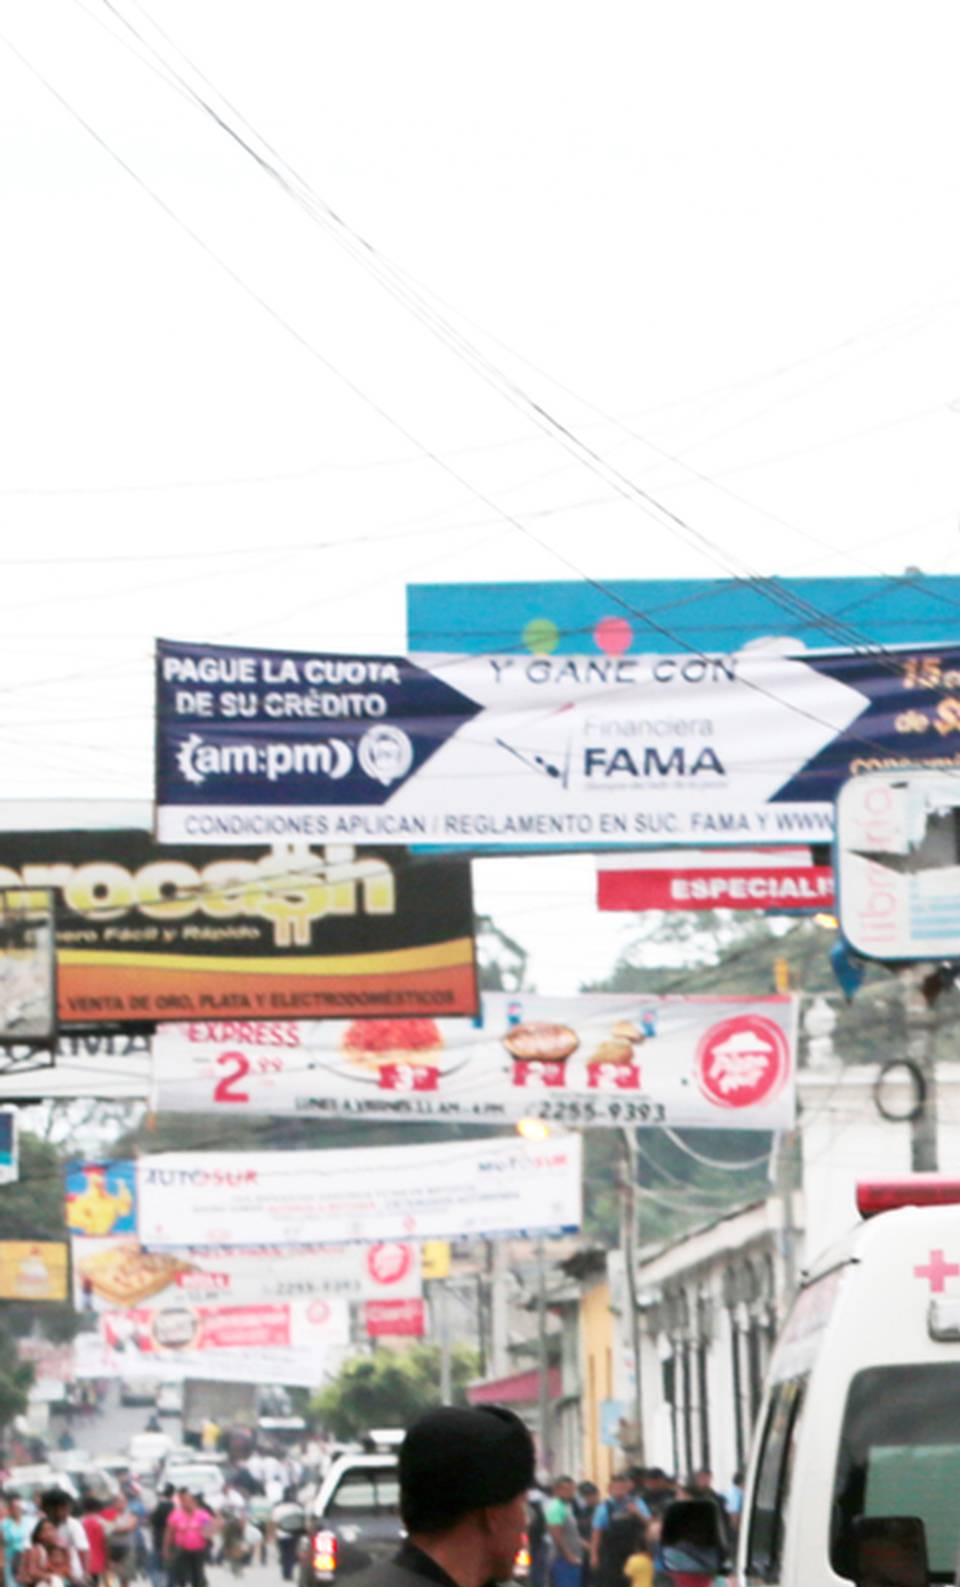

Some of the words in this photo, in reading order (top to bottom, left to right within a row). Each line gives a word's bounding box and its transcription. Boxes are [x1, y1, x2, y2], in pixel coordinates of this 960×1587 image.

[163, 657, 255, 683] PAGUE
[262, 658, 300, 684] LA
[304, 659, 401, 685] CUOTA
[490, 660, 513, 683] Y
[525, 659, 639, 683] GANE
[652, 658, 738, 682] CON
[902, 658, 941, 688] 15
[175, 692, 214, 717] DE
[220, 692, 258, 717] SU
[264, 688, 388, 718] CRÉDITO
[584, 715, 714, 737] Financiera
[893, 710, 929, 732] de
[583, 747, 726, 777] FAMA
[185, 815, 335, 834] CONDICIONES
[337, 815, 426, 834] APLICAN
[445, 814, 593, 834] REGLAMENTO
[601, 814, 626, 833] EN
[634, 813, 680, 833] SUC.
[691, 812, 750, 832] FAMA
[753, 812, 767, 831] Y
[67, 995, 124, 1011] VENTA
[129, 995, 149, 1010] DE
[200, 992, 250, 1009] PLATA
[257, 992, 265, 1007] Y
[189, 1021, 300, 1047] EXPRESS
